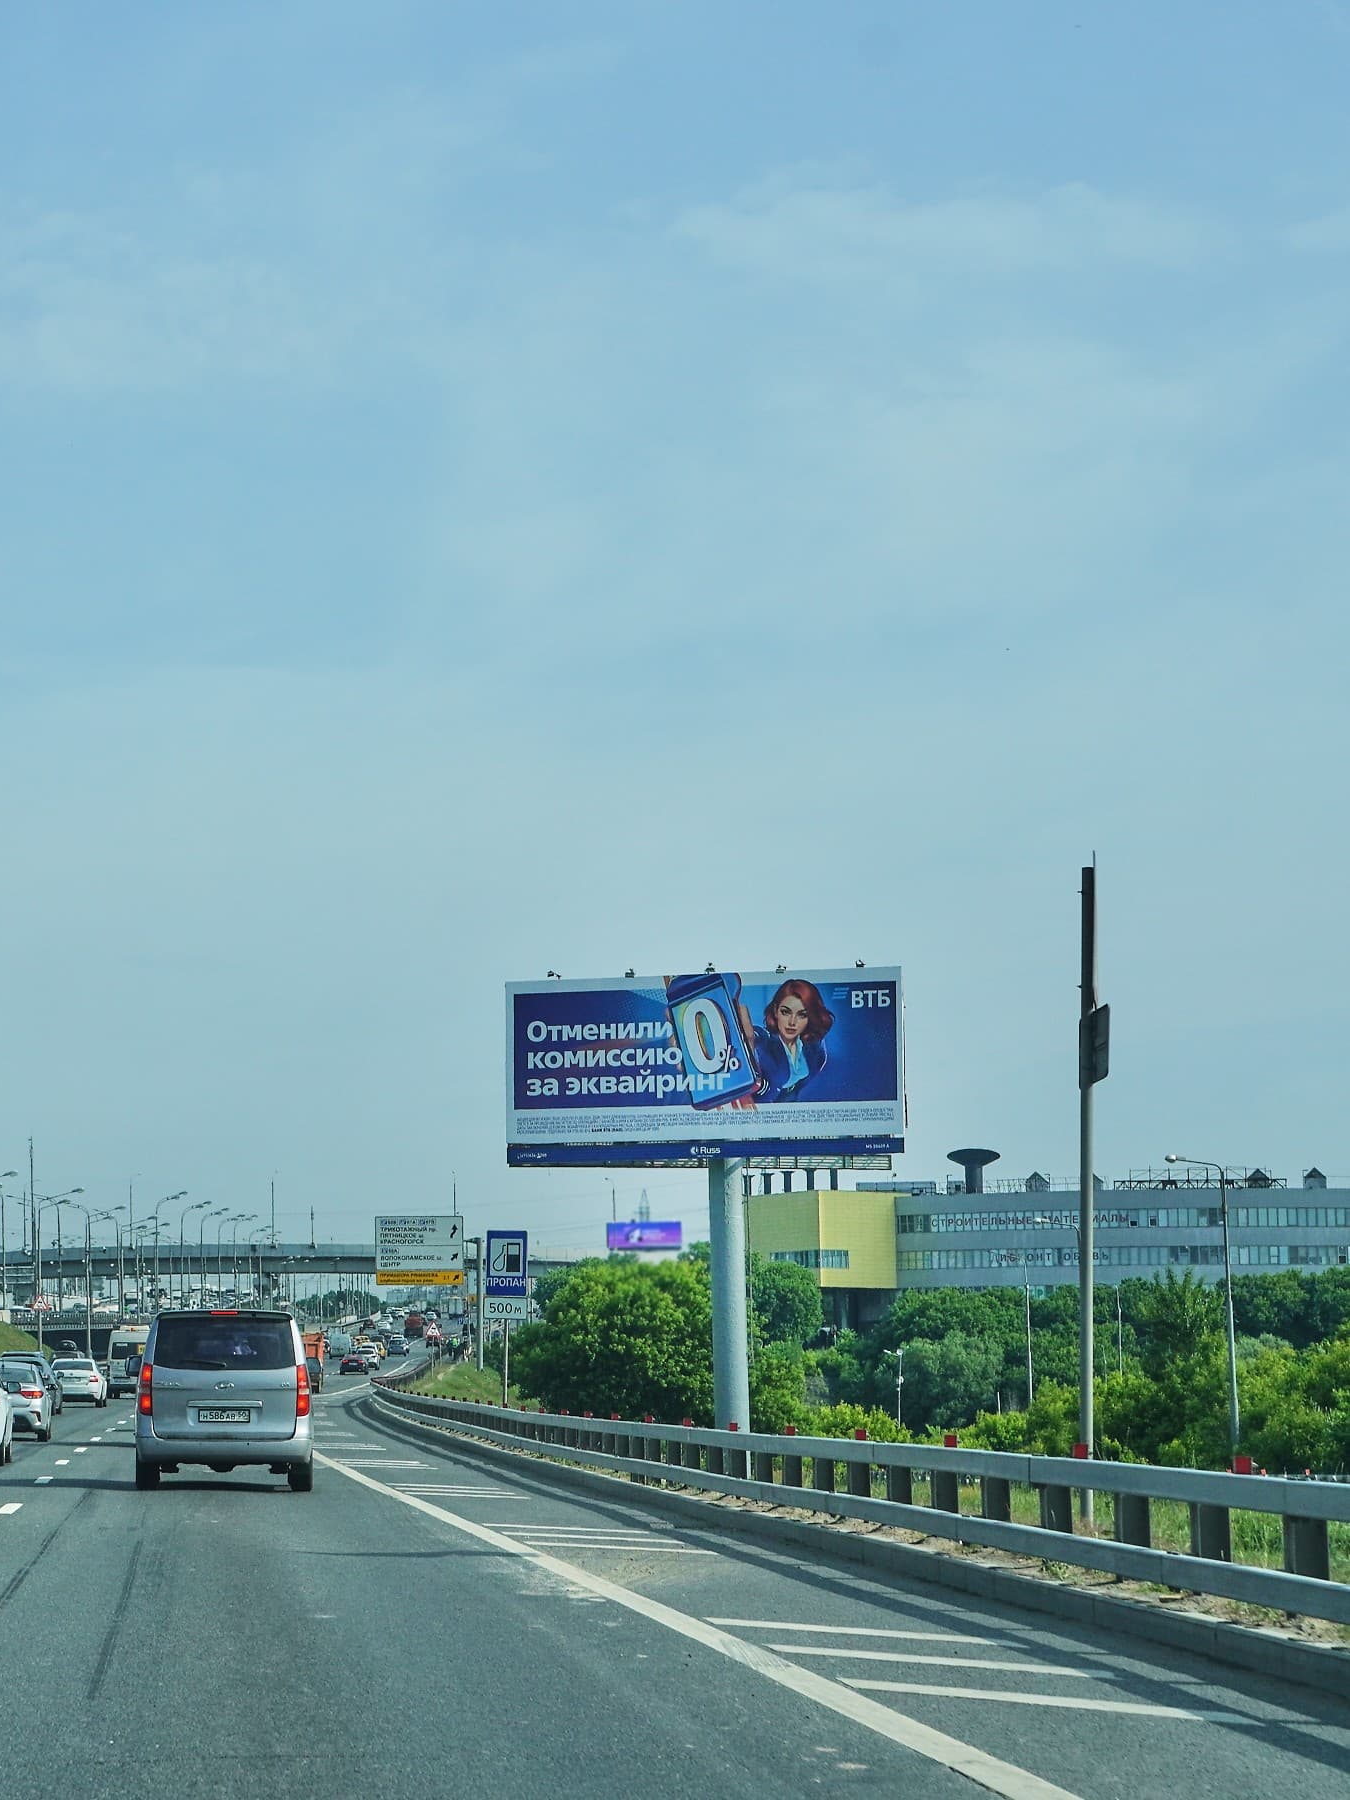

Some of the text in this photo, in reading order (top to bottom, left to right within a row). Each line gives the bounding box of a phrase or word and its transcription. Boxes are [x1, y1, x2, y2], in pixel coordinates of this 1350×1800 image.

[851, 990, 891, 1009] ВТБ
[526, 1020, 673, 1042] Отменили
[682, 998, 739, 1075] 0%
[526, 1046, 683, 1070] комиссию
[526, 1068, 731, 1098] за эквайринг
[700, 1146, 721, 1154] Russ
[931, 1216, 1033, 1228] СТРОИТЕЛЬНЫЕ
[1063, 1251, 1110, 1262] ОБВЬ
[486, 1277, 526, 1287] ПРОПАН
[489, 1302, 522, 1314] 500 м
